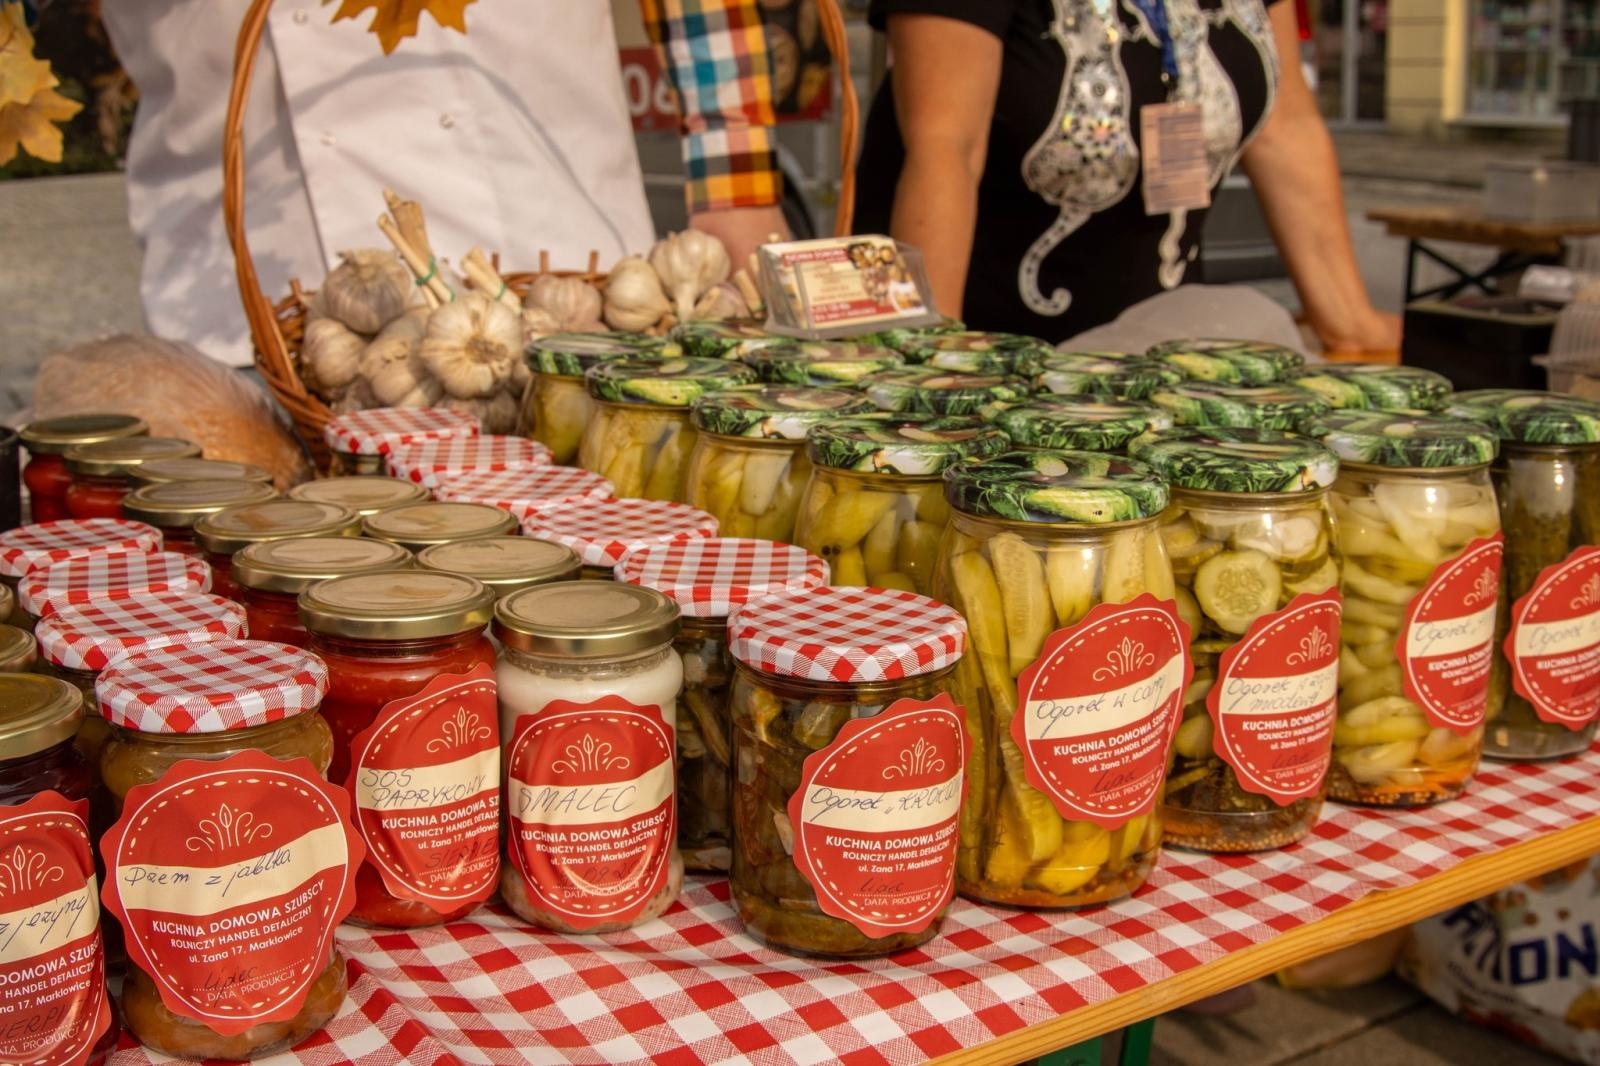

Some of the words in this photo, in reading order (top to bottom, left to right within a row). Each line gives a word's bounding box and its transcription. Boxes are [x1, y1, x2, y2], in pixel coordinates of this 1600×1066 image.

[1242, 719, 1288, 731] KUCHNIA
[1054, 739, 1106, 756] KUCHNIA
[1108, 722, 1152, 747] DOMOWA
[1072, 750, 1113, 765] ROLNICZY
[1114, 741, 1141, 756] HANDEL
[361, 768, 414, 788] SOS
[519, 785, 637, 813] SMALEC
[382, 815, 438, 830] KUCHNIA
[441, 800, 486, 823] DOMOWA
[570, 827, 629, 842] DOMOWA
[631, 808, 667, 833] SZUBSCY
[400, 826, 444, 840] ROLNICZY
[446, 819, 473, 833] HANDEL
[536, 843, 574, 854] ROLNICZY
[576, 843, 612, 853] HANDEL
[613, 827, 658, 850] DETALICZNY
[826, 835, 881, 851] KUCHNIA
[885, 833, 934, 849] DOMOWA
[418, 842, 429, 850] ul.
[431, 839, 452, 848] Zana
[561, 856, 584, 865] Zana
[601, 844, 647, 862] Marklowice
[842, 851, 887, 862] ROLNICZY
[888, 850, 919, 861] HANDEL
[205, 875, 223, 886] z
[858, 865, 869, 873] ul.
[871, 864, 893, 873] Zana
[152, 920, 206, 937] KUCHNIA
[209, 907, 281, 932] DOMOWA
[284, 879, 325, 914] SZUBSCY
[864, 897, 888, 906] DATA
[170, 938, 215, 951] ROLNICZY
[218, 928, 261, 945] HANDEL
[263, 904, 313, 935] DETALICZNY
[70, 933, 100, 964] SZUB
[189, 955, 199, 964] ul.
[203, 949, 229, 963] Zana
[249, 926, 304, 951] Marklowice
[0, 1003, 14, 1014] na
[36, 978, 92, 1005] Marklowice
[5, 981, 49, 999] HANDEL
[207, 990, 237, 1001] DATA
[241, 970, 295, 995] PRODUKCJI
[23, 1025, 80, 1051] PRODUKCJ
